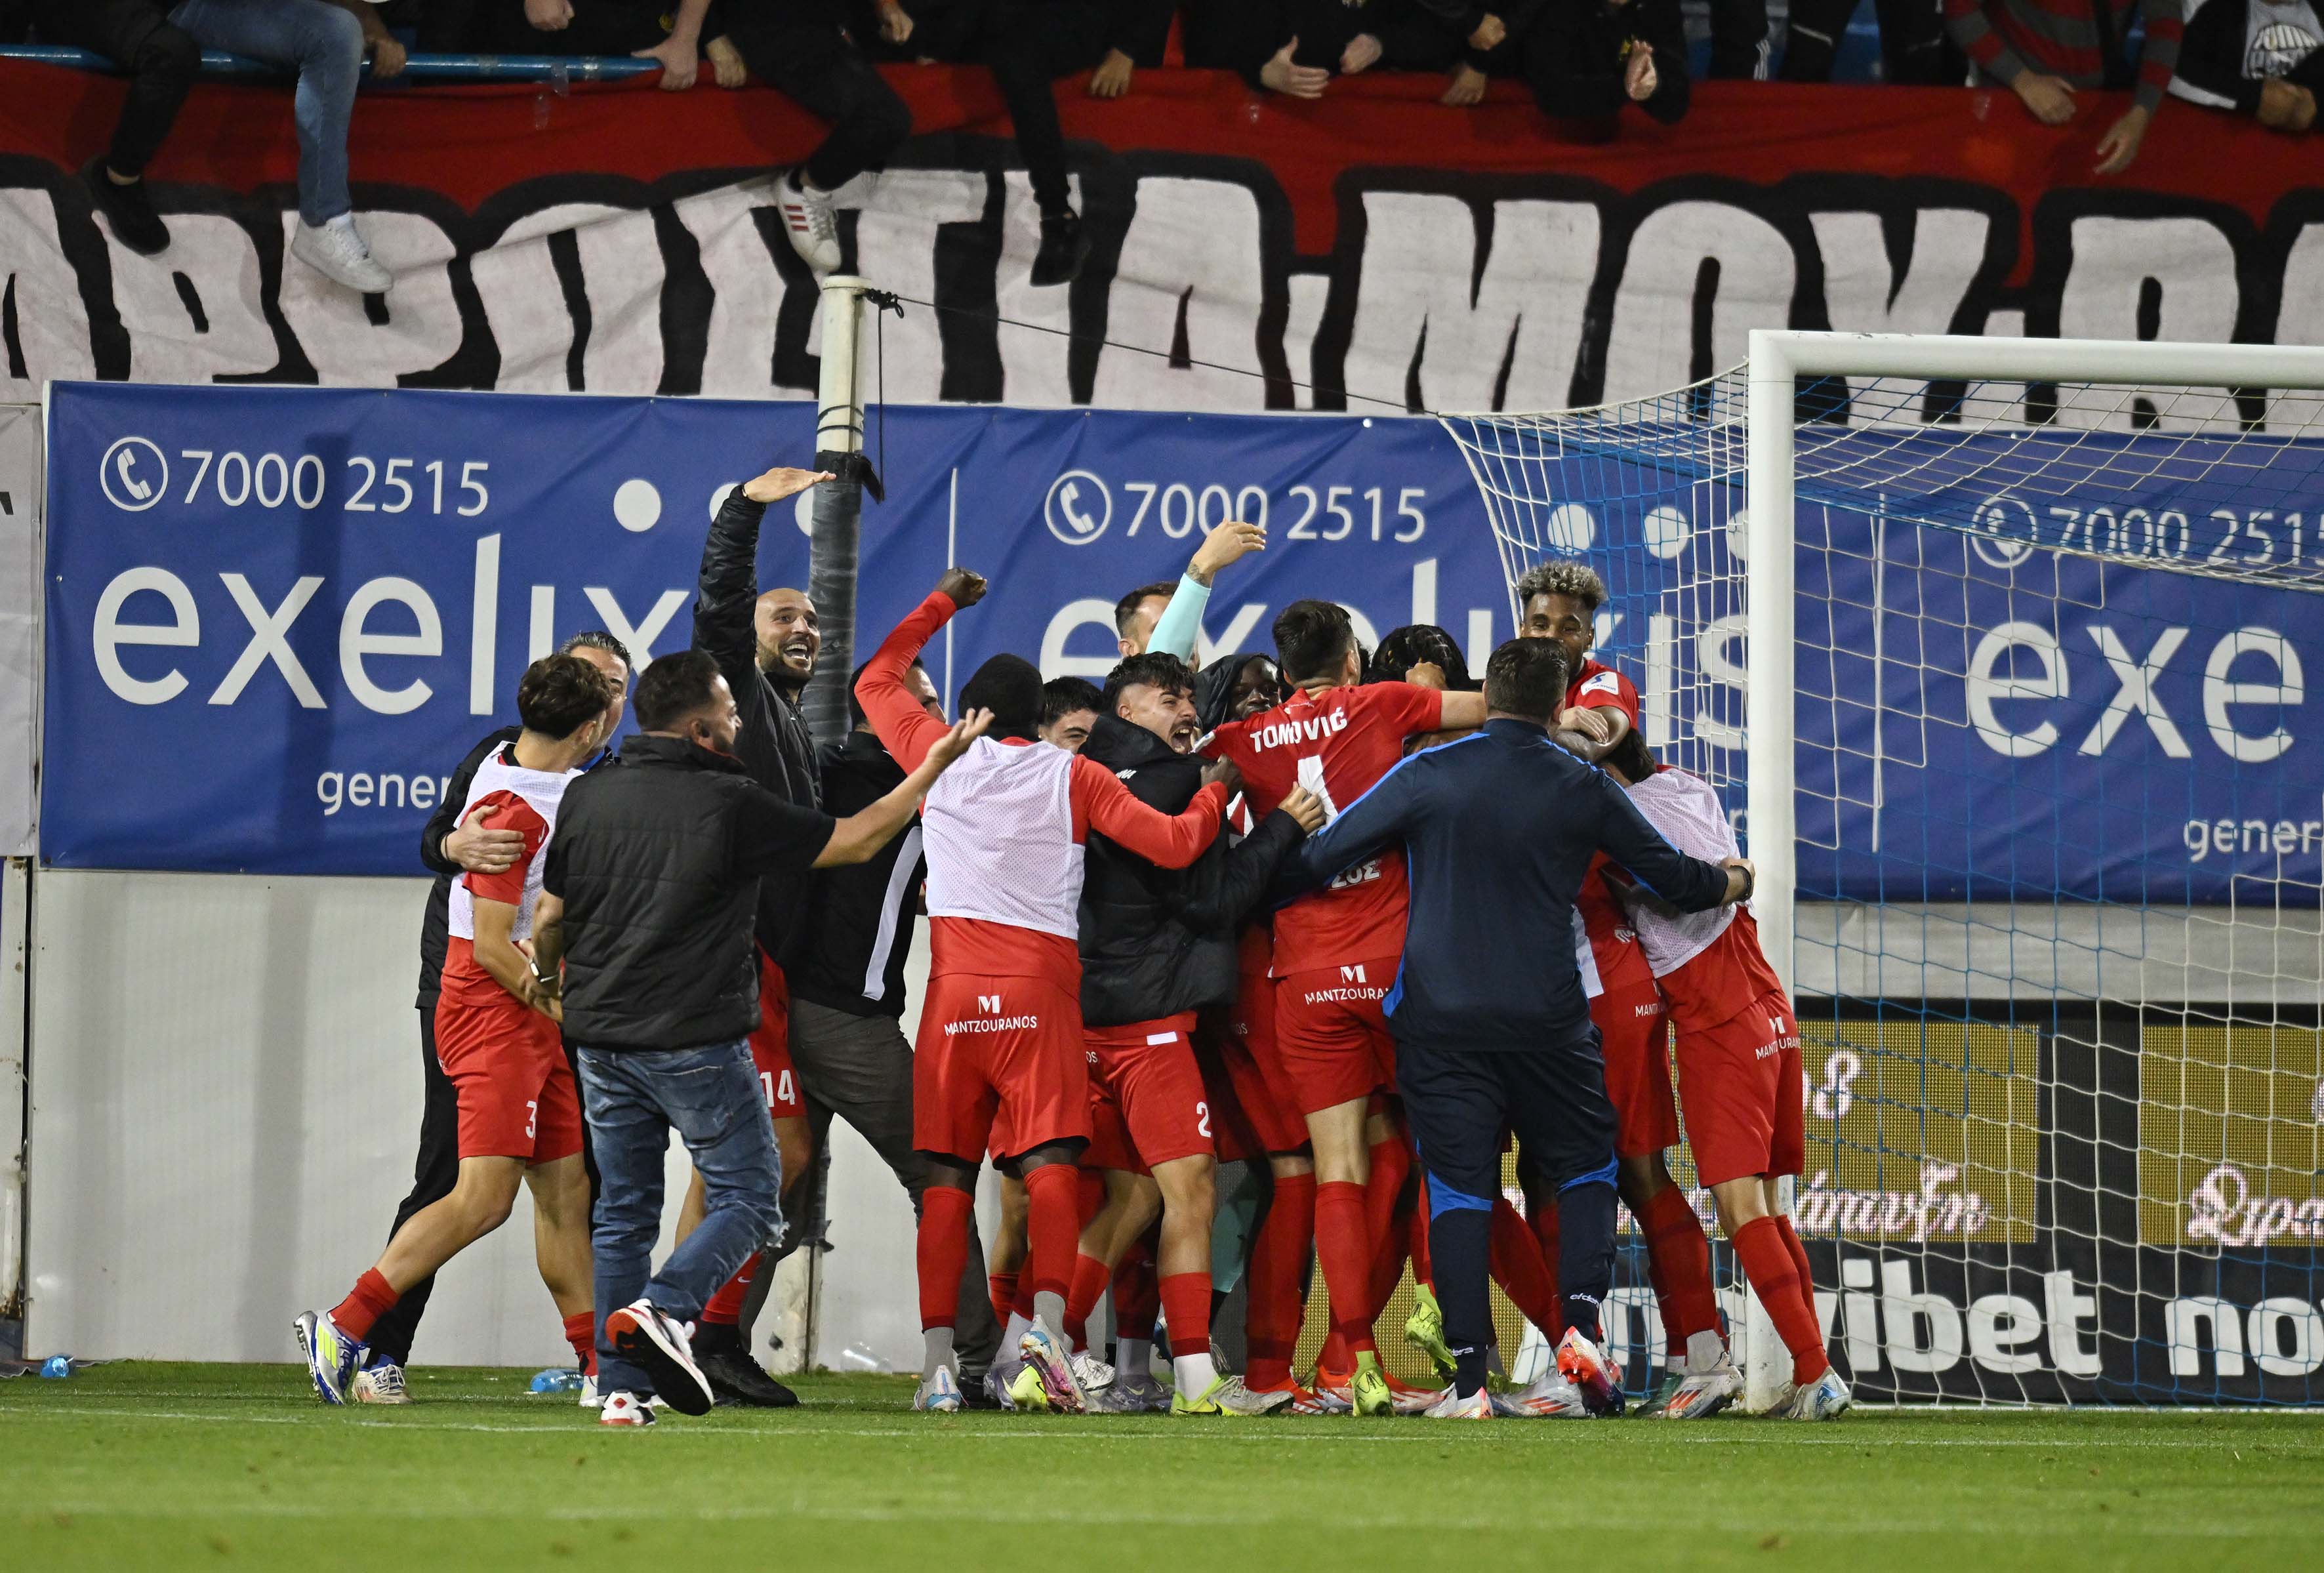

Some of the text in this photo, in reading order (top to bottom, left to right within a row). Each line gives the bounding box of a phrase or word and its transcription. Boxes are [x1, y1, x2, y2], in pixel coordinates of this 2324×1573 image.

[182, 450, 489, 517] 7000 2515
[1124, 483, 1426, 542] 7000 2515
[2207, 508, 2324, 567] 251
[1250, 706, 1348, 753] TOMOVIĆ
[317, 771, 452, 816] gener
[1304, 986, 1389, 1005] MANTZOURA
[945, 1015, 1037, 1036] MANTZOURANOS
[760, 1069, 795, 1108] 14
[525, 1100, 538, 1139] 3
[1196, 1101, 1212, 1138] 2
